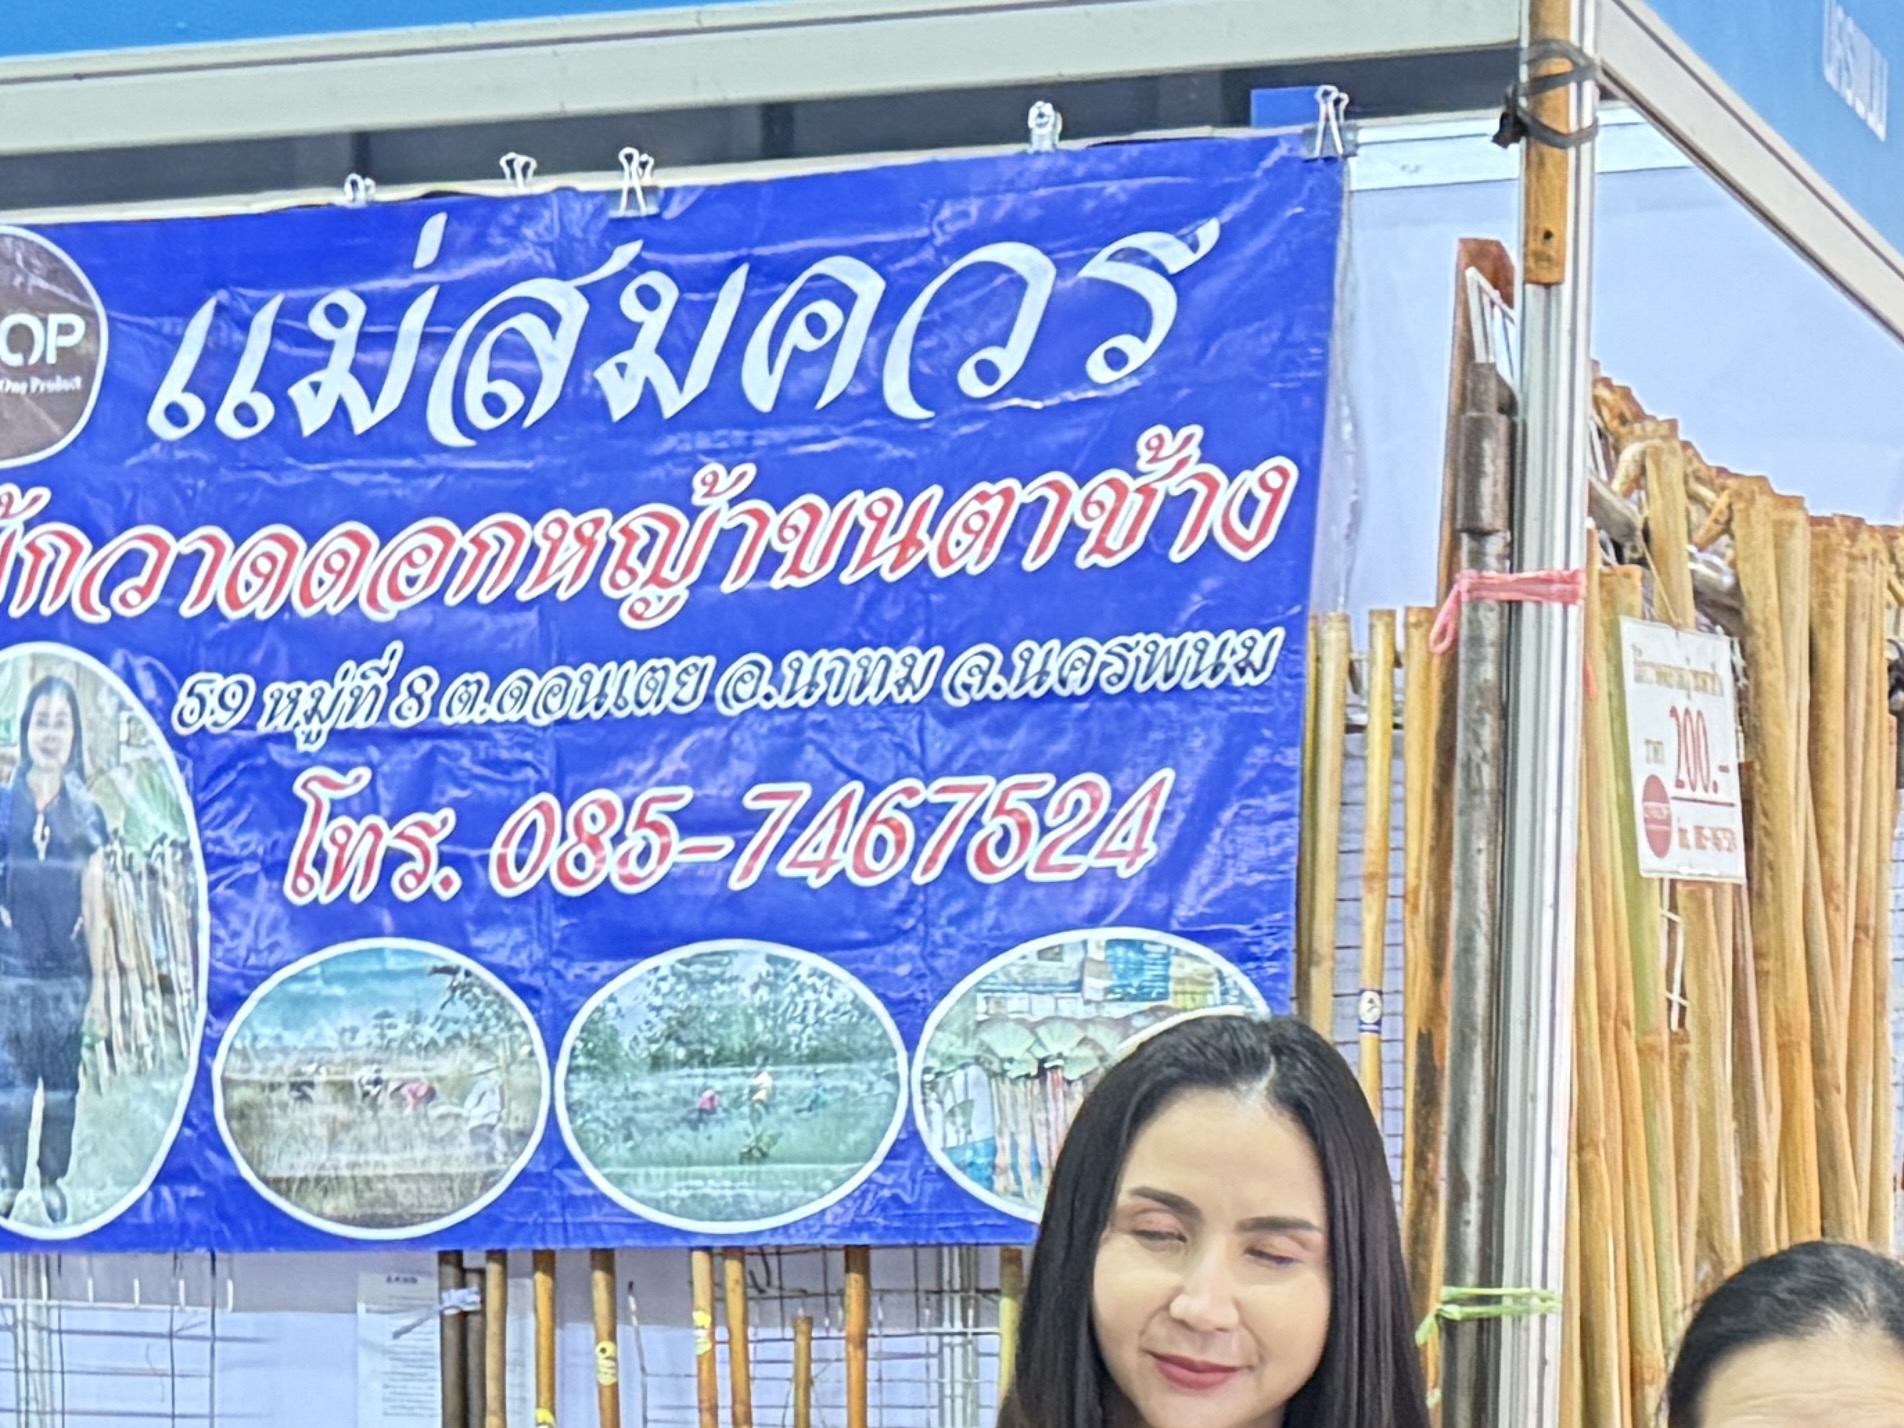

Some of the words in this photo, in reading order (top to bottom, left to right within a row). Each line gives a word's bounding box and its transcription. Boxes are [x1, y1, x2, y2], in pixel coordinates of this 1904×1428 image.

[146, 212, 1221, 447] แม่สมควร
[172, 672, 256, 736] 59
[256, 641, 404, 752] หมู่ที่
[389, 666, 439, 729] 8
[716, 644, 945, 717] อ.นาทม
[942, 627, 1286, 707] จ.นครพนม
[284, 766, 464, 906] โทร.
[490, 768, 1177, 898] 085-7467524
